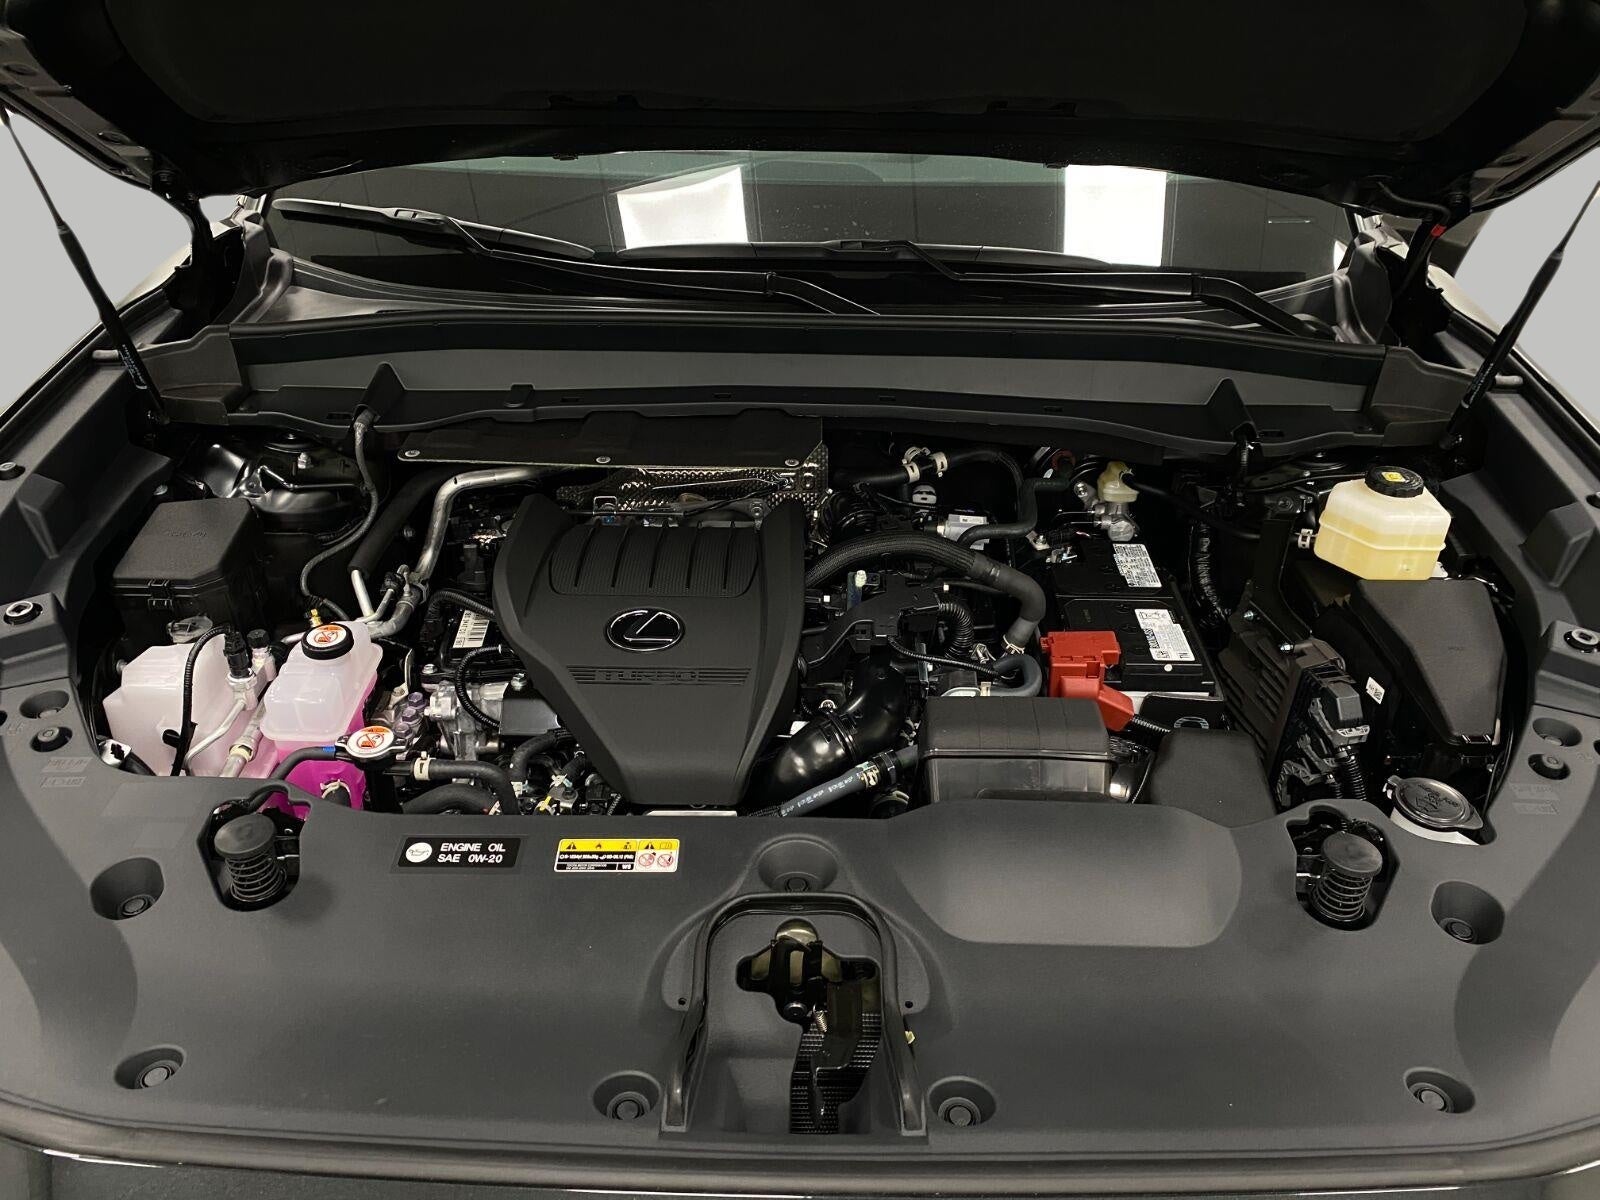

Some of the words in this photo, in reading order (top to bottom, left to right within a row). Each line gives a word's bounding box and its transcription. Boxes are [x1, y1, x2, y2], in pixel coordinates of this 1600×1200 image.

[440, 843, 482, 852] ENGINE
[488, 843, 507, 852] OIL
[437, 854, 461, 863] SAE
[467, 854, 503, 863] 0W-20
